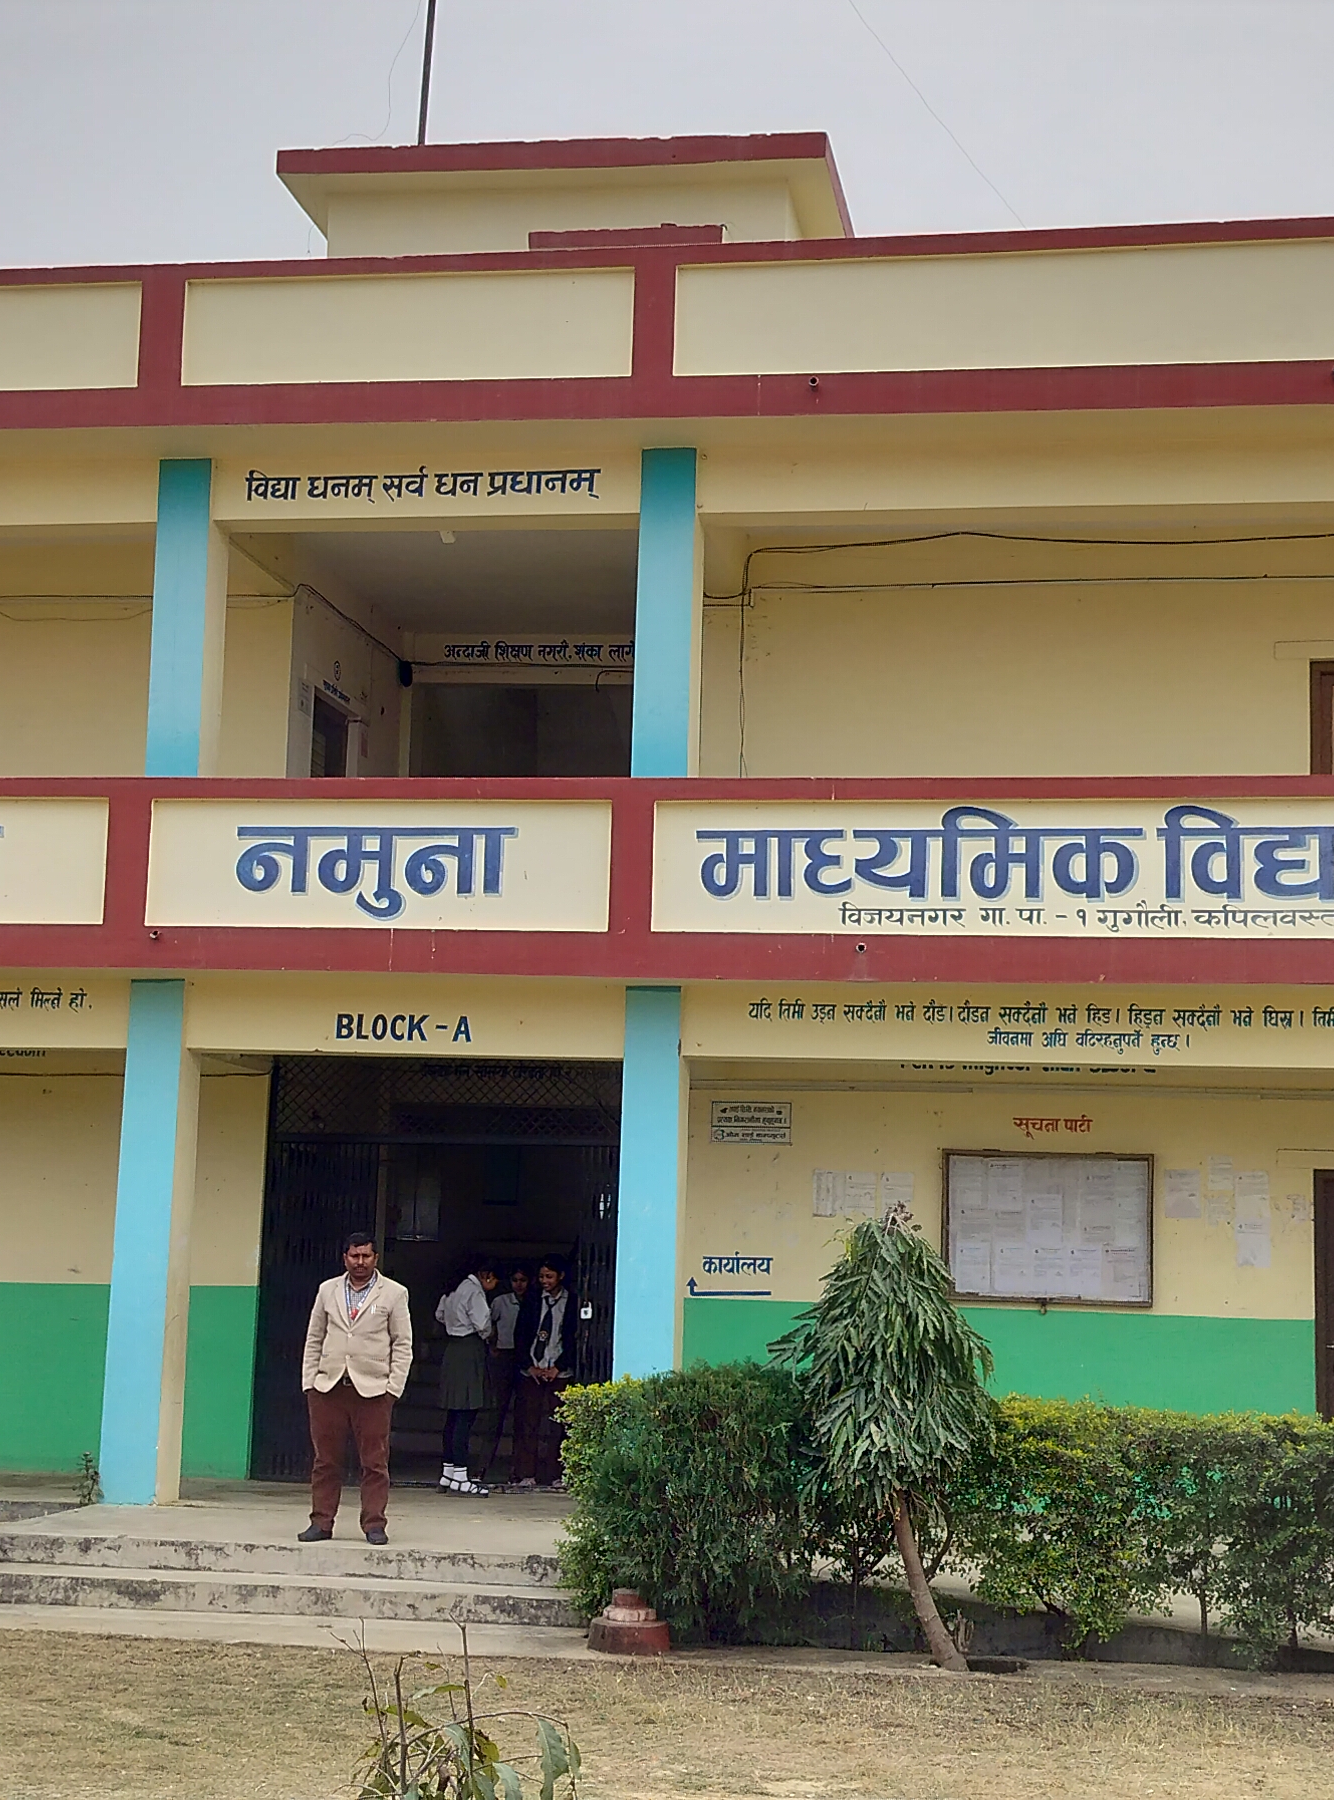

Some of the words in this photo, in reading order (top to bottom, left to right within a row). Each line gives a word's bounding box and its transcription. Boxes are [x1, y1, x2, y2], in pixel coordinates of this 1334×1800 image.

[245, 470, 300, 501] विद्या
[307, 474, 378, 504] धनम्
[382, 466, 428, 502] सर्व
[434, 472, 482, 497] धन
[487, 468, 601, 499] प्रधानम्
[696, 805, 1146, 902] माध्यमिक
[235, 825, 518, 921] नमुना
[838, 901, 966, 927] विजयनगर
[748, 997, 773, 1021] यदि
[778, 998, 806, 1021] तिमी
[987, 1026, 1034, 1047] जीवनमा
[1013, 1117, 1060, 1139] सूचना
[1064, 1116, 1093, 1133] पाटी
[703, 1251, 773, 1276] कार्यालय
